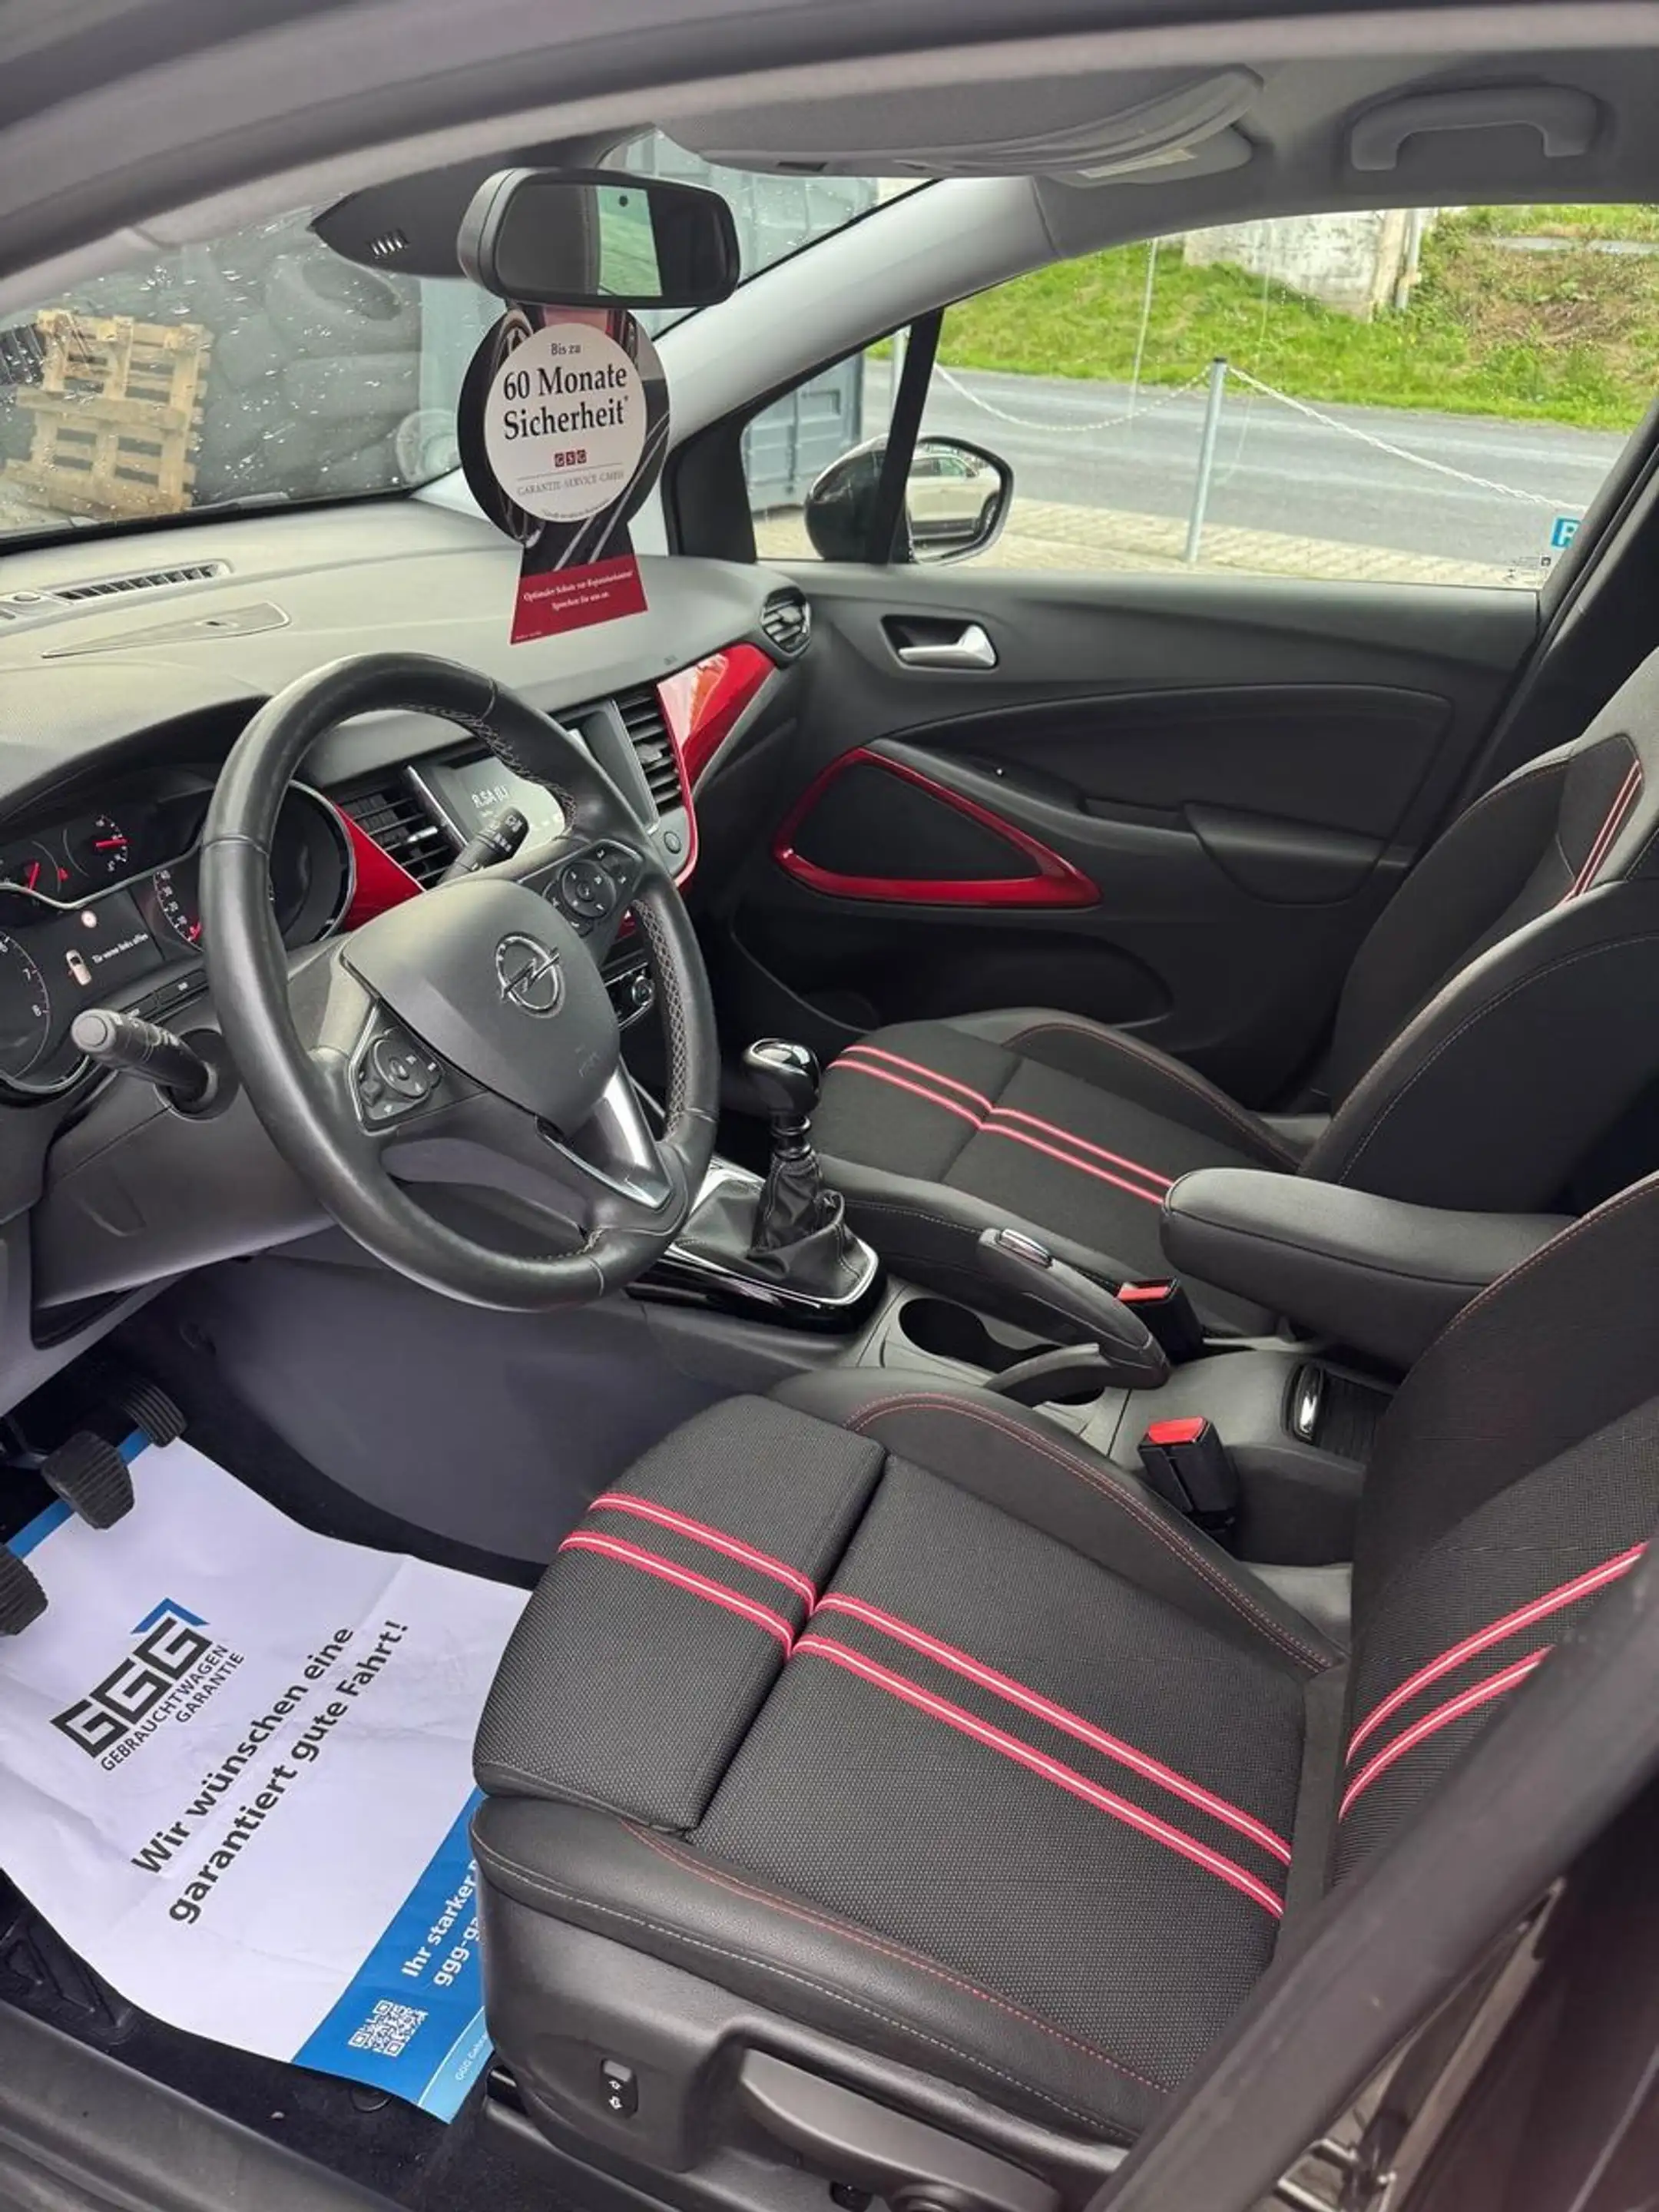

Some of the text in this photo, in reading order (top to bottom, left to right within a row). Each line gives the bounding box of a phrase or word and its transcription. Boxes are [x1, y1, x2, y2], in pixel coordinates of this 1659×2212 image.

[503, 363, 627, 400] 60 Monate
[551, 343, 581, 356] Bis zu
[31, 1004, 41, 1017] 8
[50, 1617, 213, 1758] GGG
[100, 1644, 229, 1771] GEBRAUCHTWAGEN
[174, 1651, 244, 1725] GARANTIE
[131, 1625, 353, 1874] Wir wünschen eine
[169, 1620, 409, 1925] garantiert gute Fahrt!
[401, 1875, 478, 1978] Ihr starker
